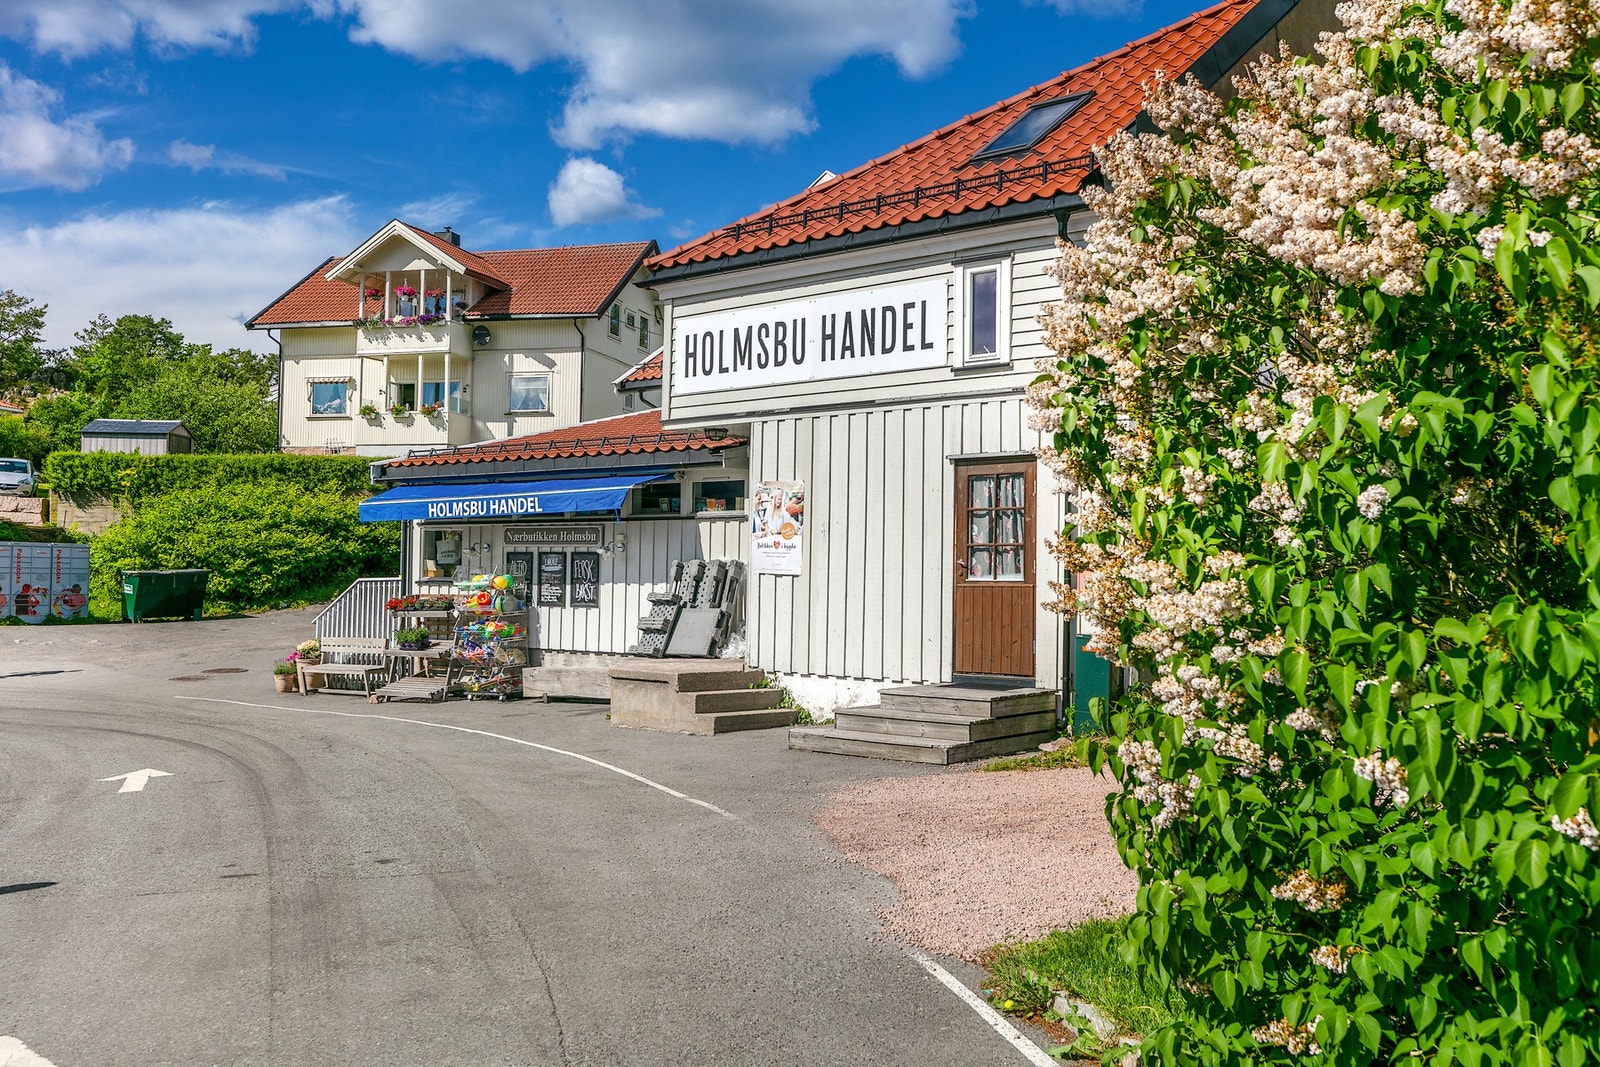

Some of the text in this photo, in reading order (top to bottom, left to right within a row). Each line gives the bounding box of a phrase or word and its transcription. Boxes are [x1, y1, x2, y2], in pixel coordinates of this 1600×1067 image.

[684, 300, 934, 378] HOLMSBU HANDEL
[428, 497, 543, 518] HOLMSBU HANDEL
[506, 531, 597, 542] Nærbutikken Holmsbu
